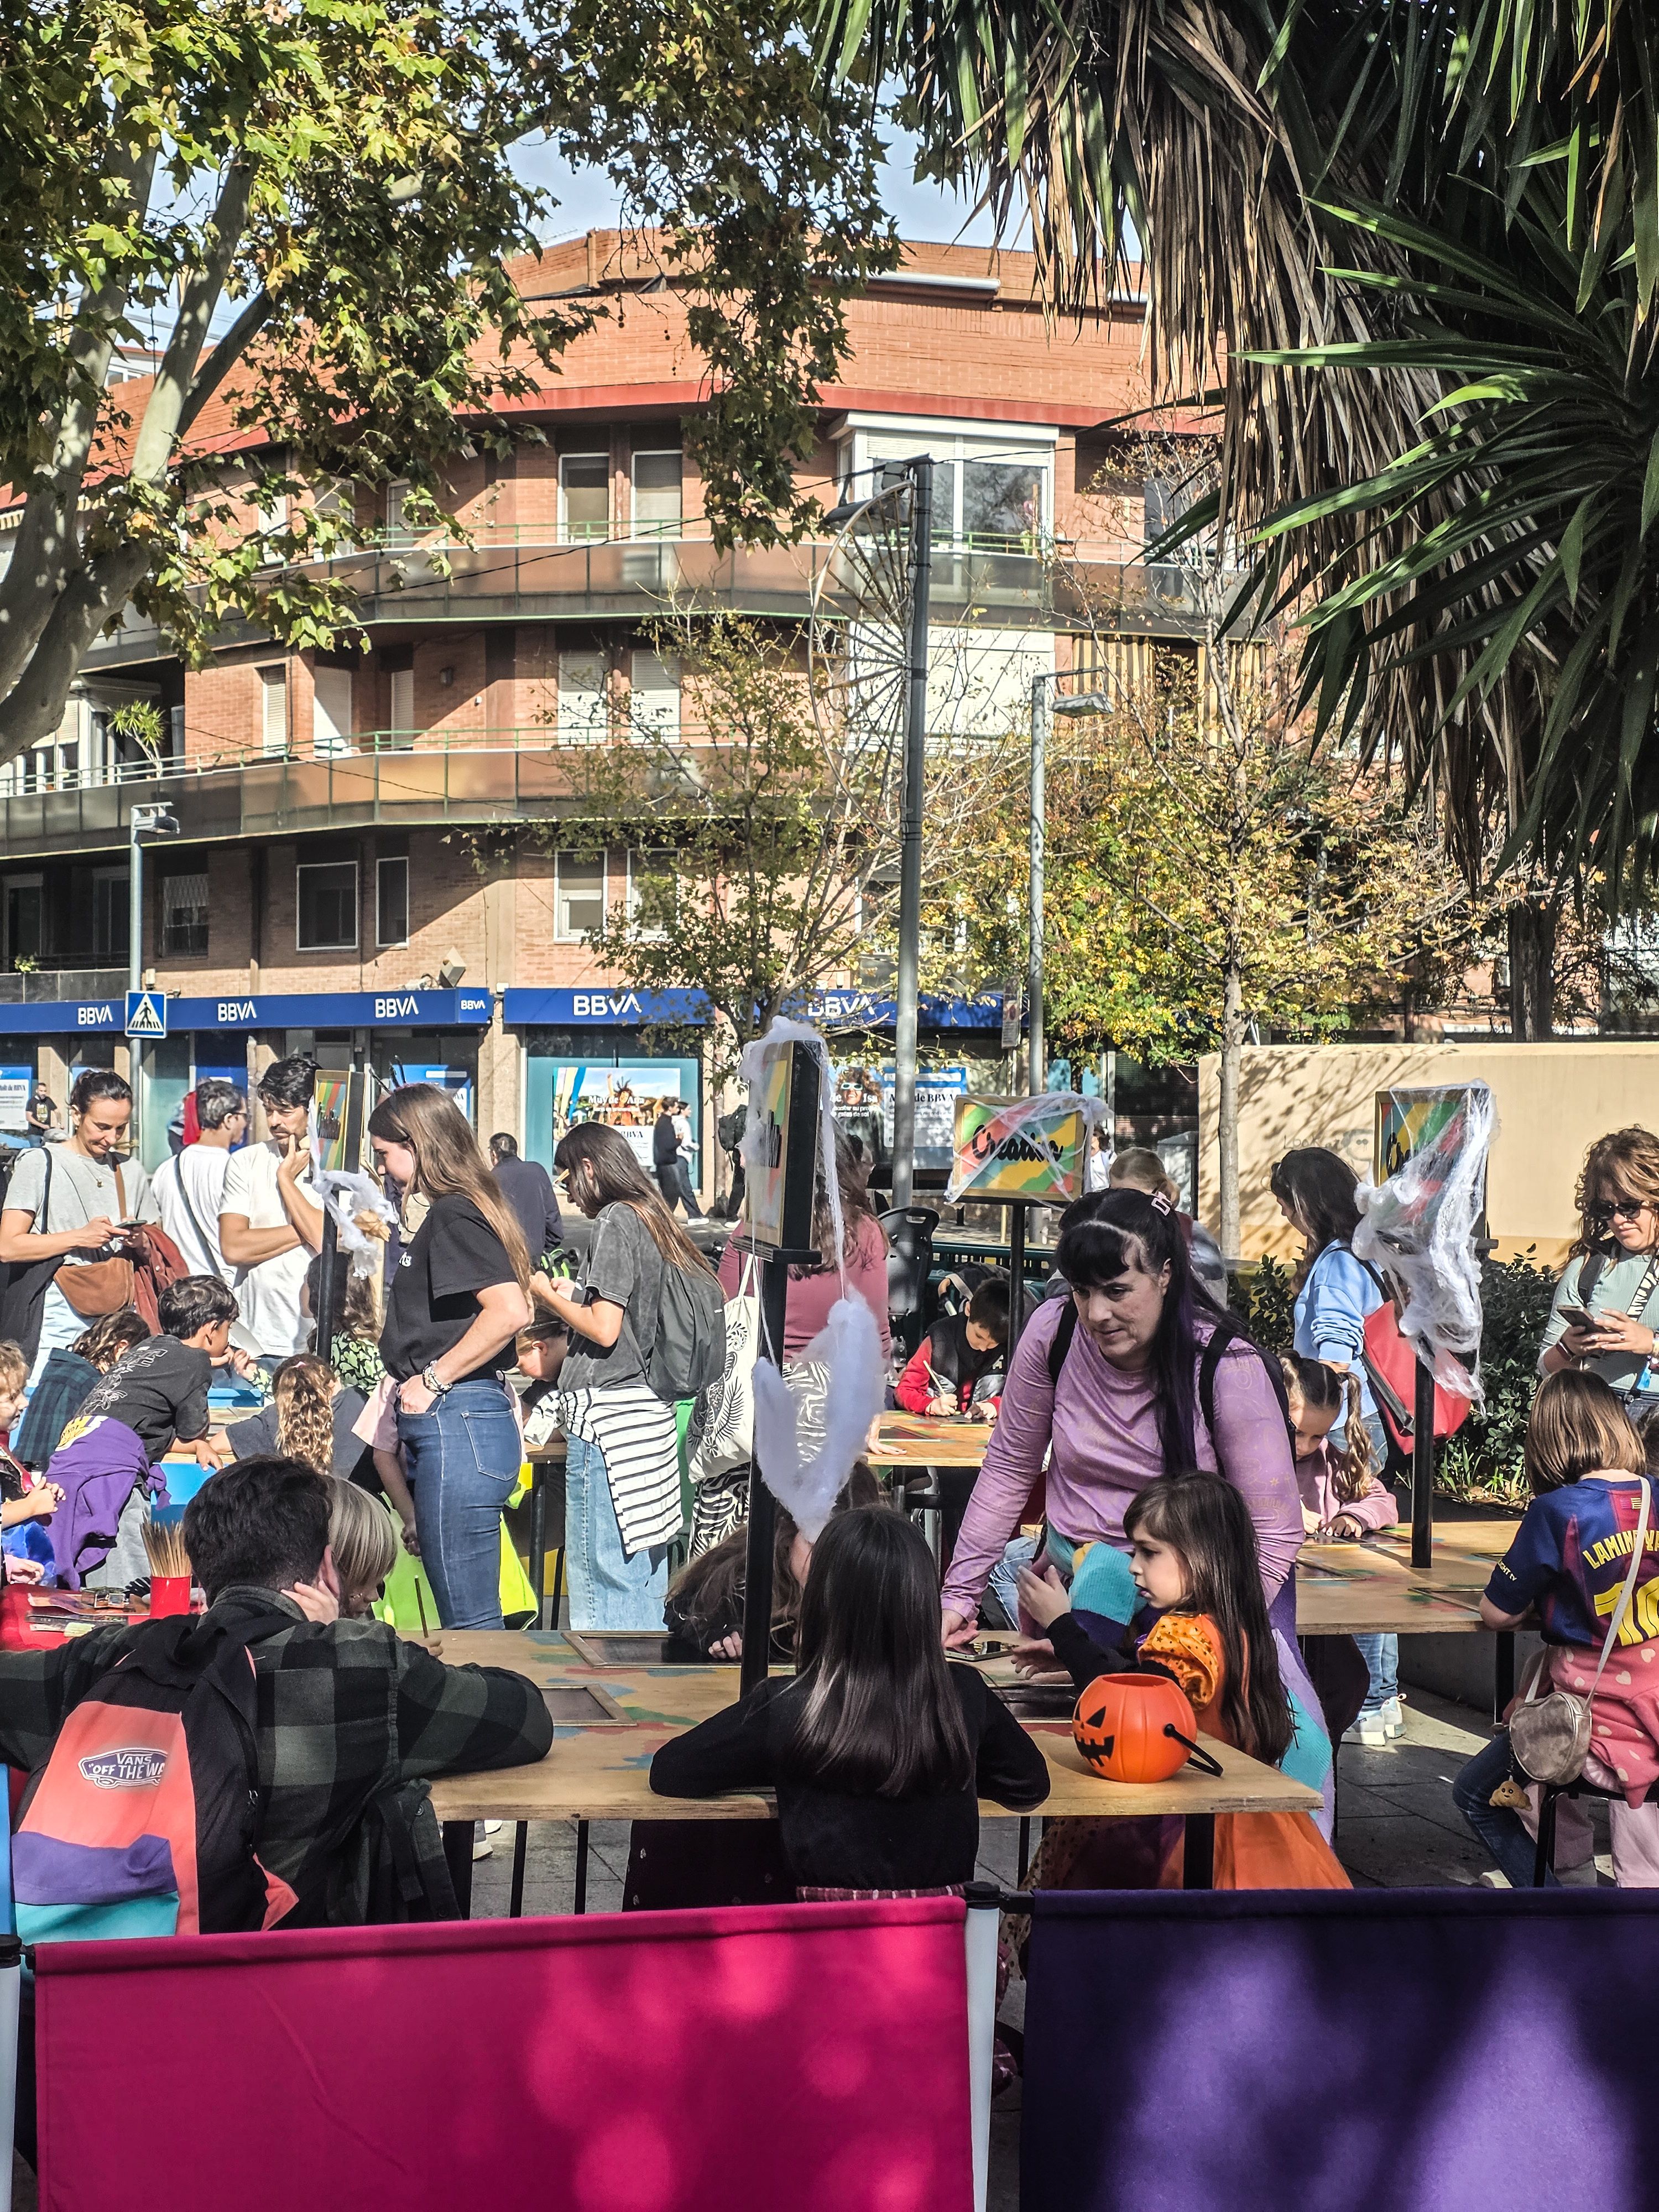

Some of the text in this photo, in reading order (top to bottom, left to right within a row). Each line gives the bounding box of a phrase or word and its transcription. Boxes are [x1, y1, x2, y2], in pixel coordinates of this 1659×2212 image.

[217, 1000, 257, 1022] BBVA
[374, 995, 419, 1018] BBVA
[460, 999, 486, 1010] BBVA
[573, 993, 642, 1016] BBVA
[77, 1004, 113, 1025] BBVA
[927, 1094, 955, 1102] BBVA
[116, 1752, 153, 1765] VANS
[118, 1764, 145, 1779] THE
